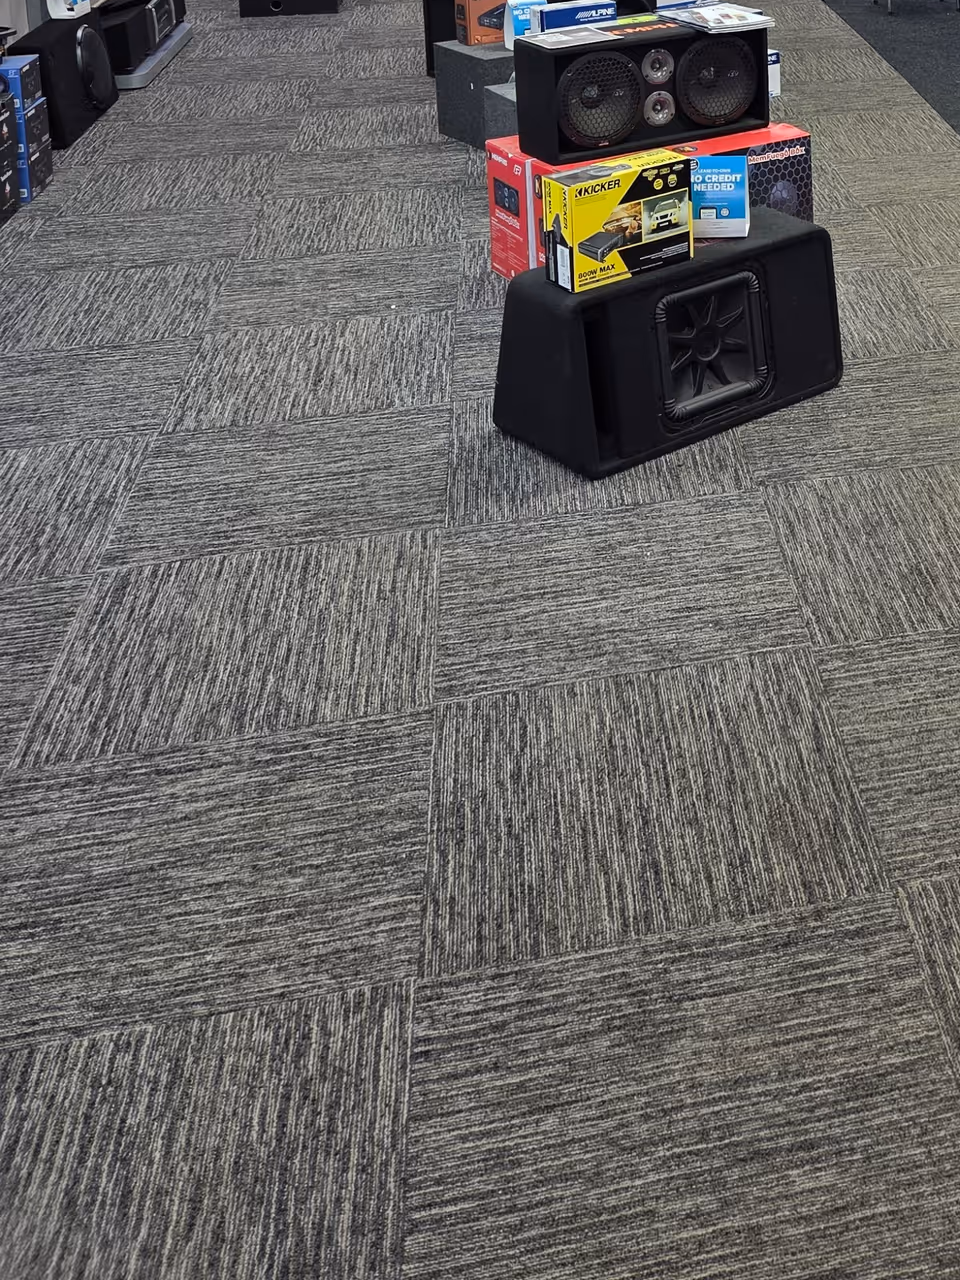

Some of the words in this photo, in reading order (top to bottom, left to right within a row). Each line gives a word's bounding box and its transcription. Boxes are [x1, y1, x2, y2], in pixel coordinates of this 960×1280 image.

[575, 7, 615, 19] ALPINE
[704, 173, 742, 183] CREDIT
[581, 178, 621, 197] KICKER
[694, 182, 735, 192] NEEDED
[561, 188, 569, 230] KICKER
[578, 268, 598, 280] 800W
[599, 263, 616, 274] MAX
